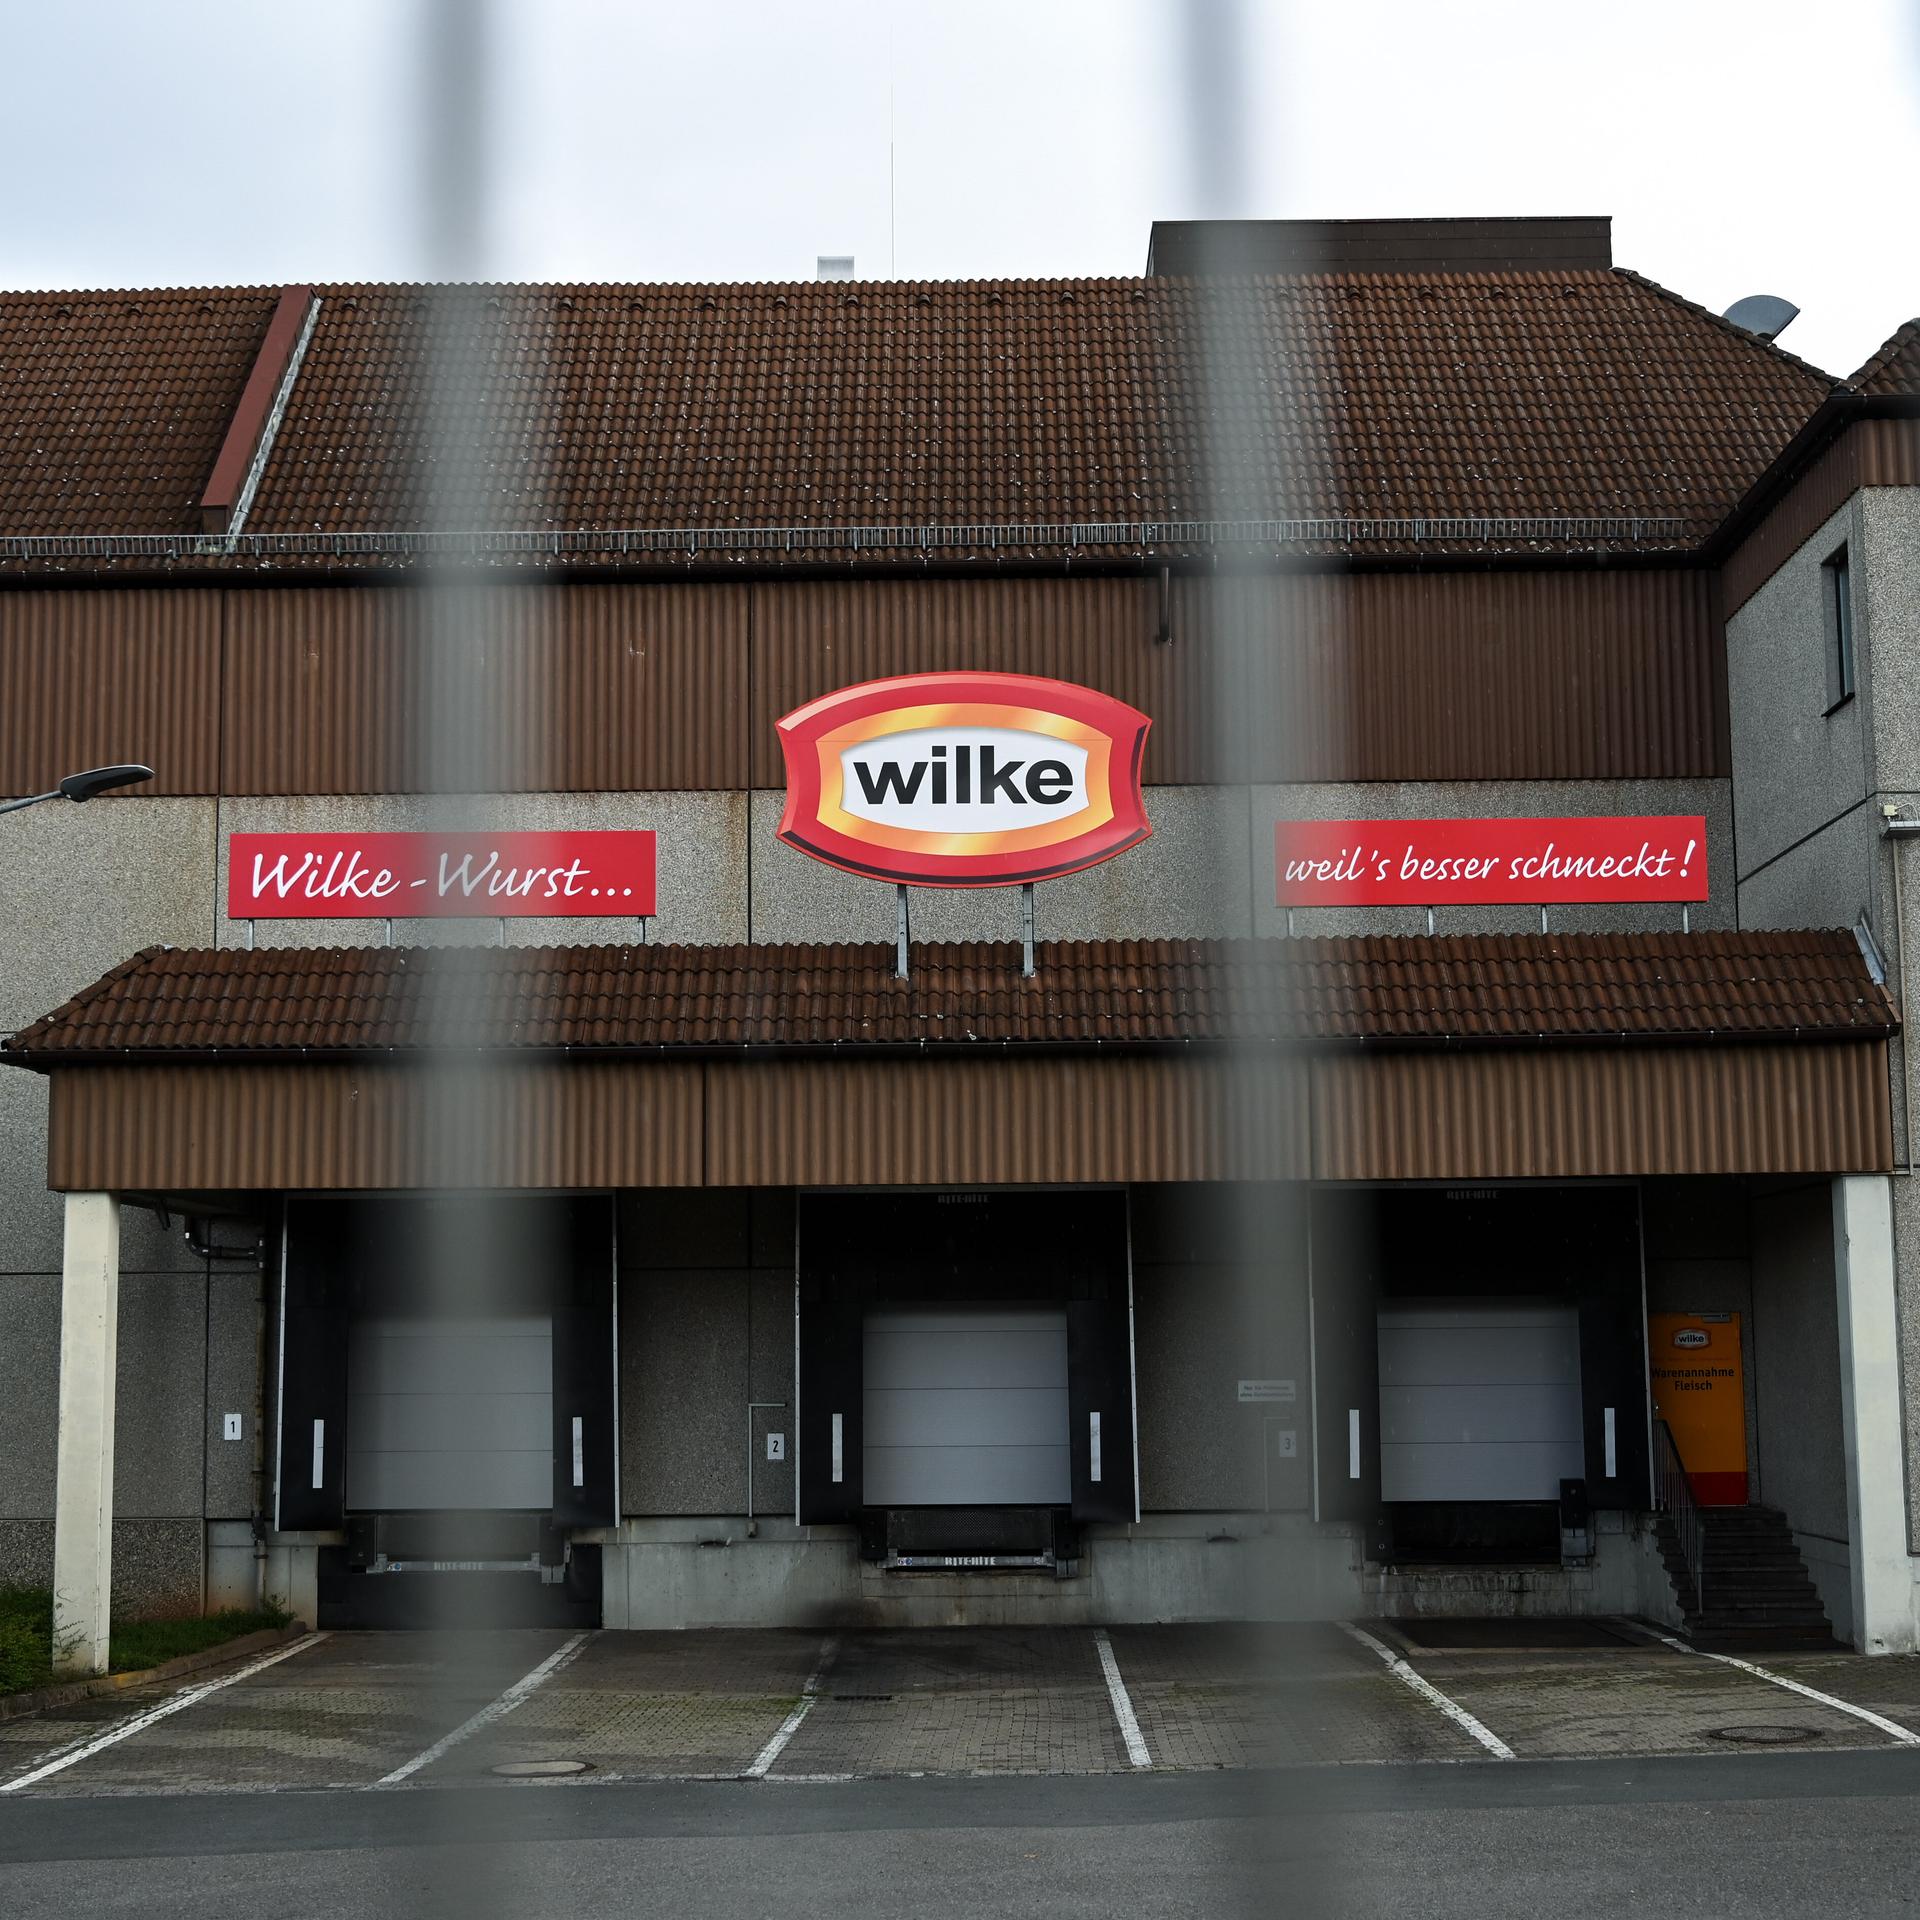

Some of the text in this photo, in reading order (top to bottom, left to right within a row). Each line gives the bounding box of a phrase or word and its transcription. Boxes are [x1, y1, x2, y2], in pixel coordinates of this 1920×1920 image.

[853, 745, 1073, 805] wilke
[252, 851, 401, 898] Wilke
[1284, 839, 1696, 882] weil's besser schmeckt!
[1678, 1334, 1705, 1343] wilke
[1674, 1380, 1713, 1391] Fleisch
[773, 1440, 779, 1453] 2
